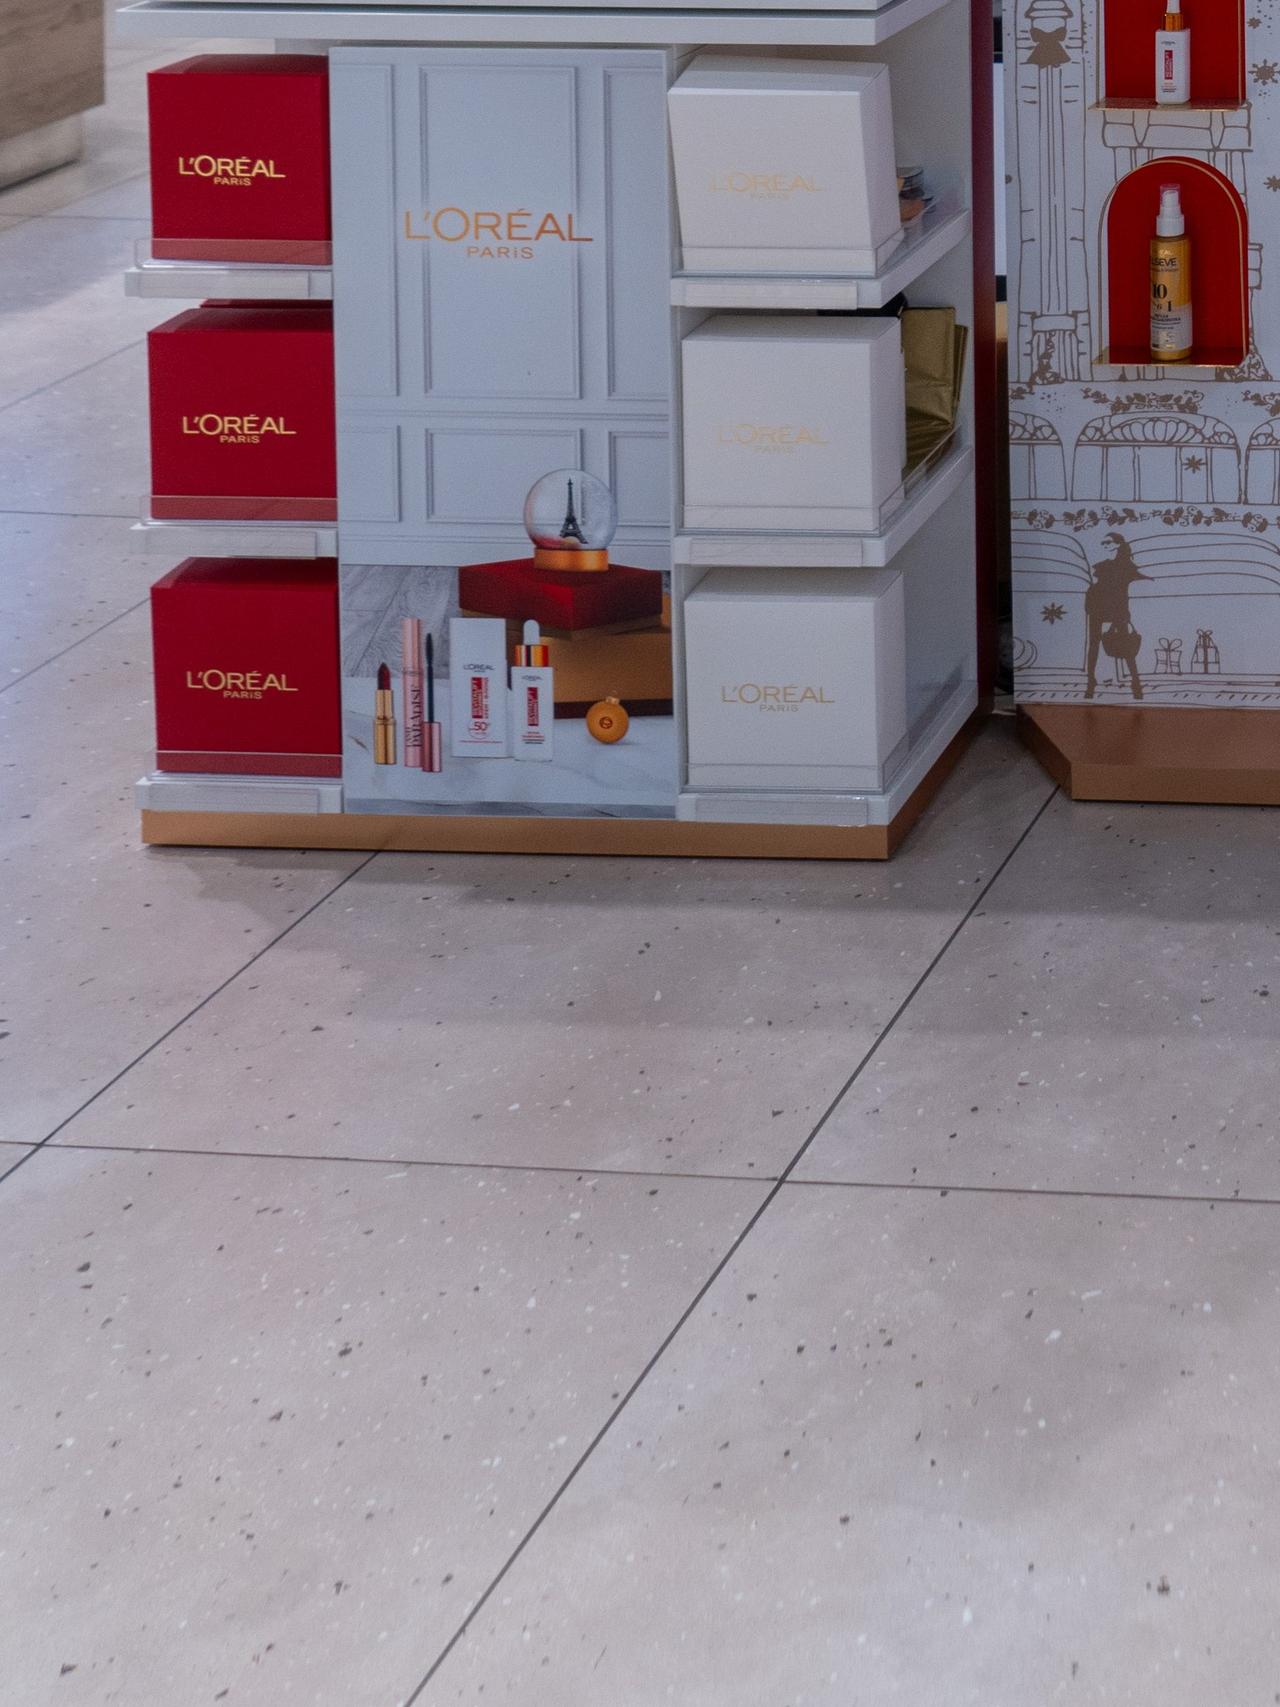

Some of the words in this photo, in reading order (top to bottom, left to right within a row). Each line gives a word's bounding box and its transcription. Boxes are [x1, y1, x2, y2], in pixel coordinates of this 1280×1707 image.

[178, 155, 286, 178] L'ORÉAL
[405, 207, 594, 242] L'ORÉAL
[183, 413, 297, 435] L'ORÉAL
[186, 669, 299, 692] L'ORÉAL
[721, 683, 836, 704] L'ORÉAL
[411, 684, 423, 747] PARADISE
